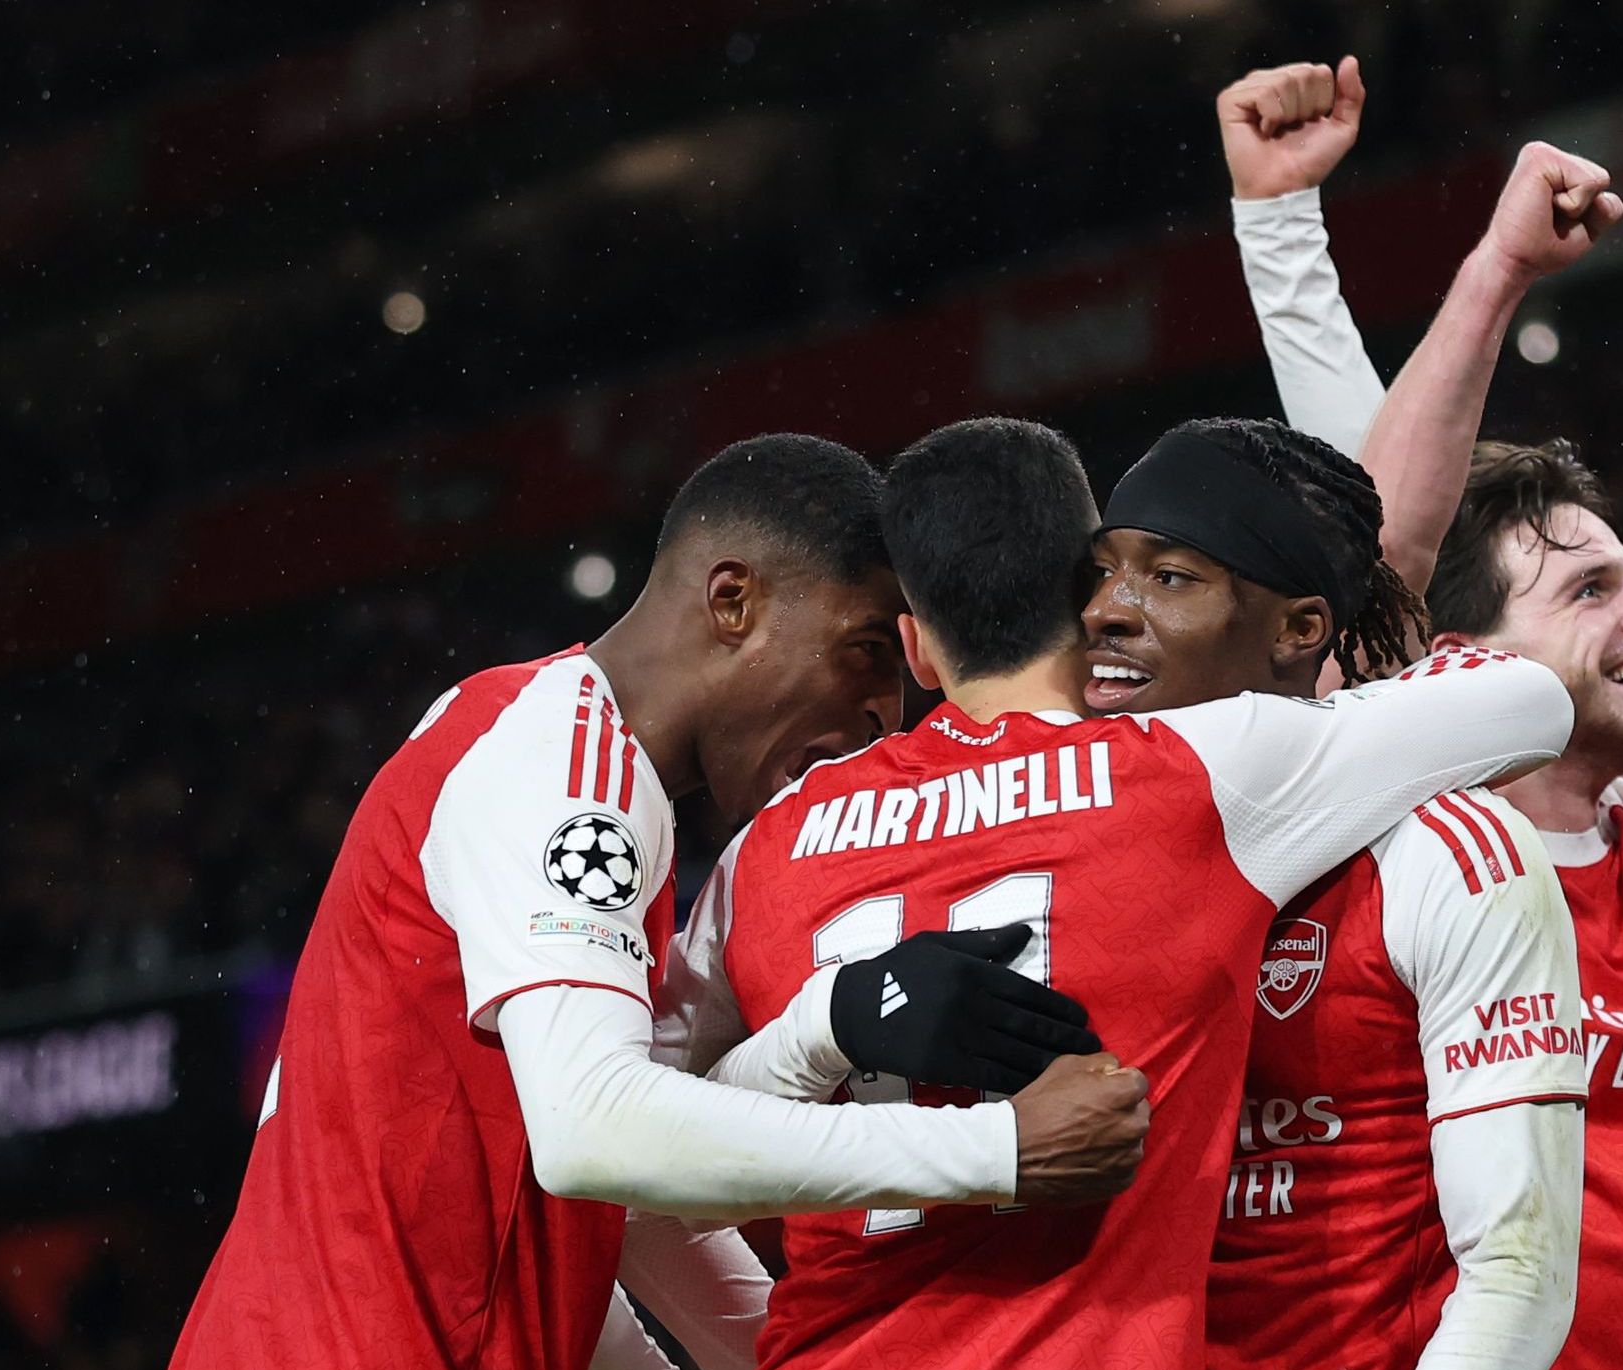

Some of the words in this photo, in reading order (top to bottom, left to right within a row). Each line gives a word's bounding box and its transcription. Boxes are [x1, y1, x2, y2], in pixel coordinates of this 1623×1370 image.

[788, 740, 1114, 861] MARTINELLI
[1473, 992, 1556, 1032] VISIT
[1444, 1026, 1585, 1074] RWANDA
